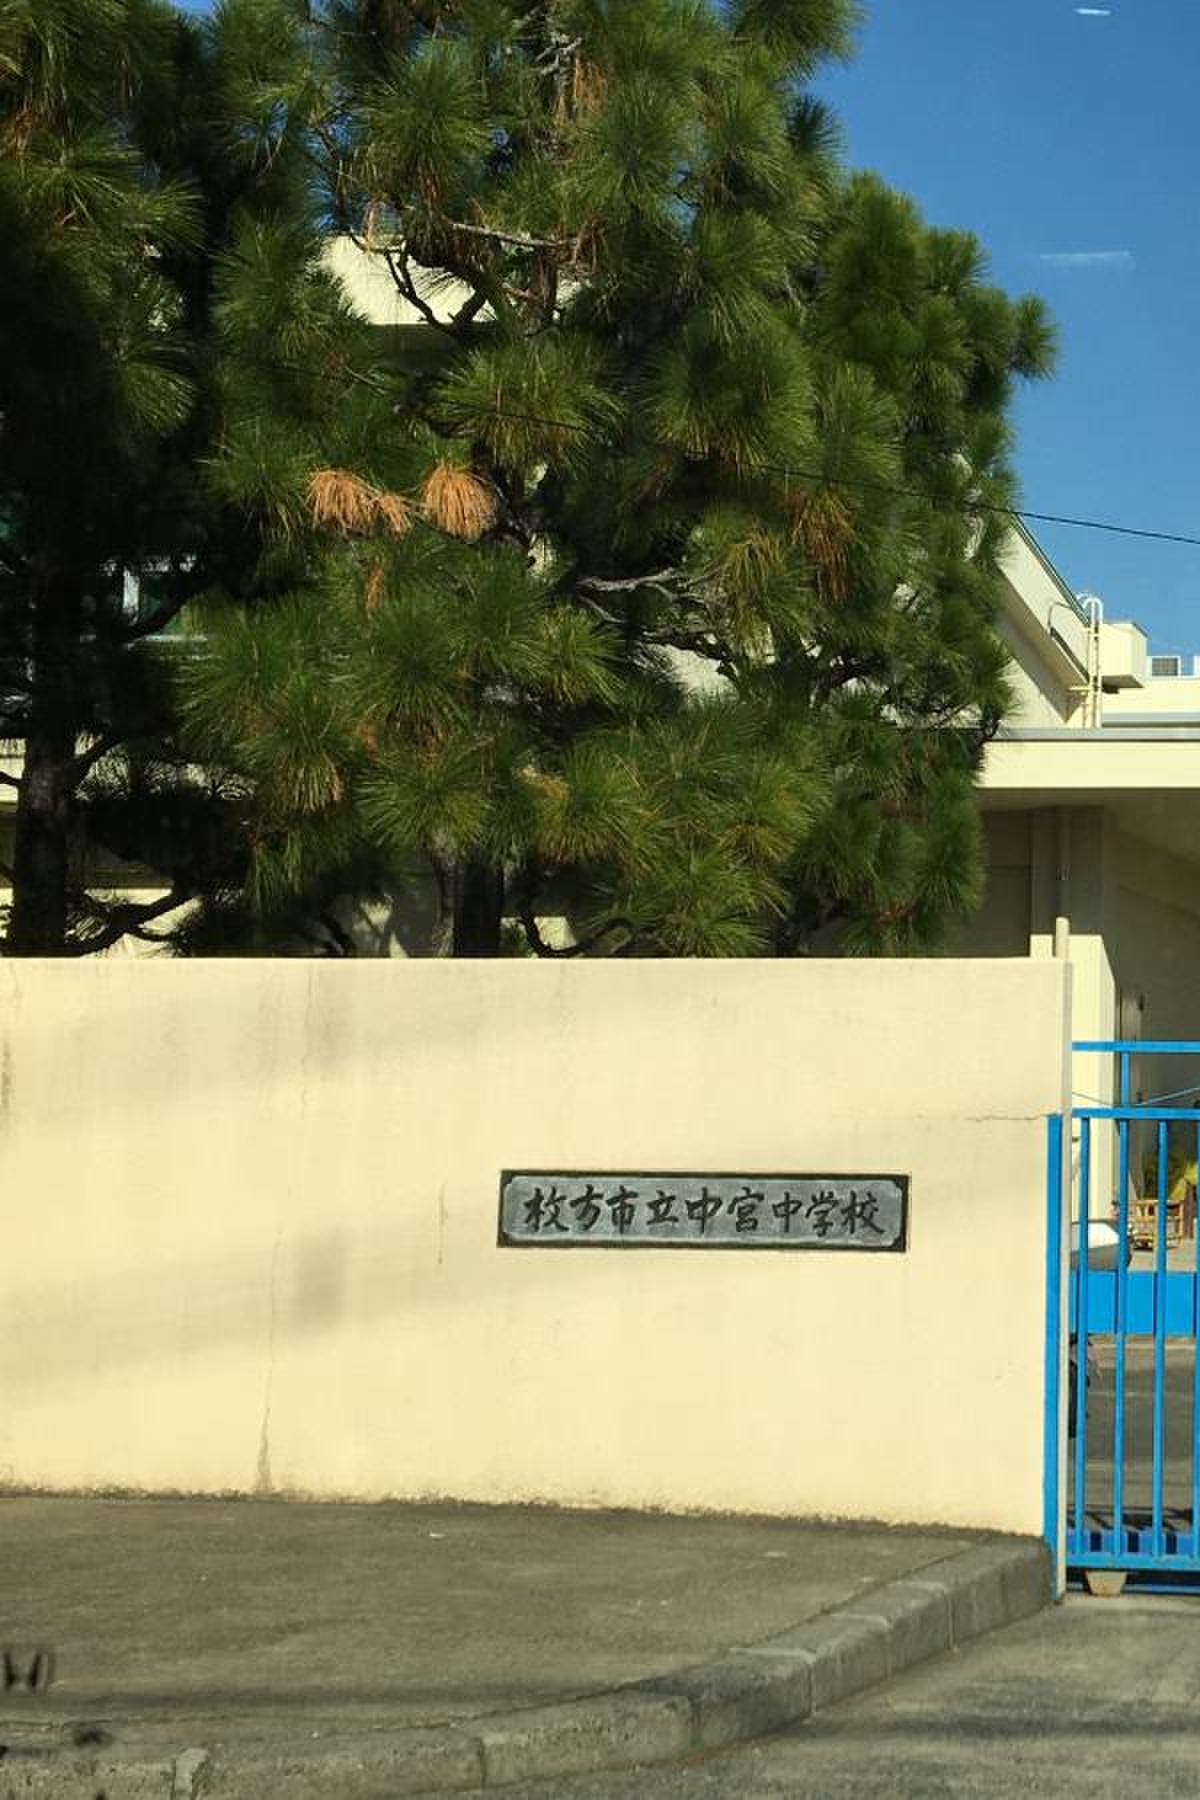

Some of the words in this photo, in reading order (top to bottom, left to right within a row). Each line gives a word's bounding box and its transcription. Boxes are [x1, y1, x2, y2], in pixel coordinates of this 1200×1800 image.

[523, 1184, 885, 1237] 枚方市立中宮中学校
